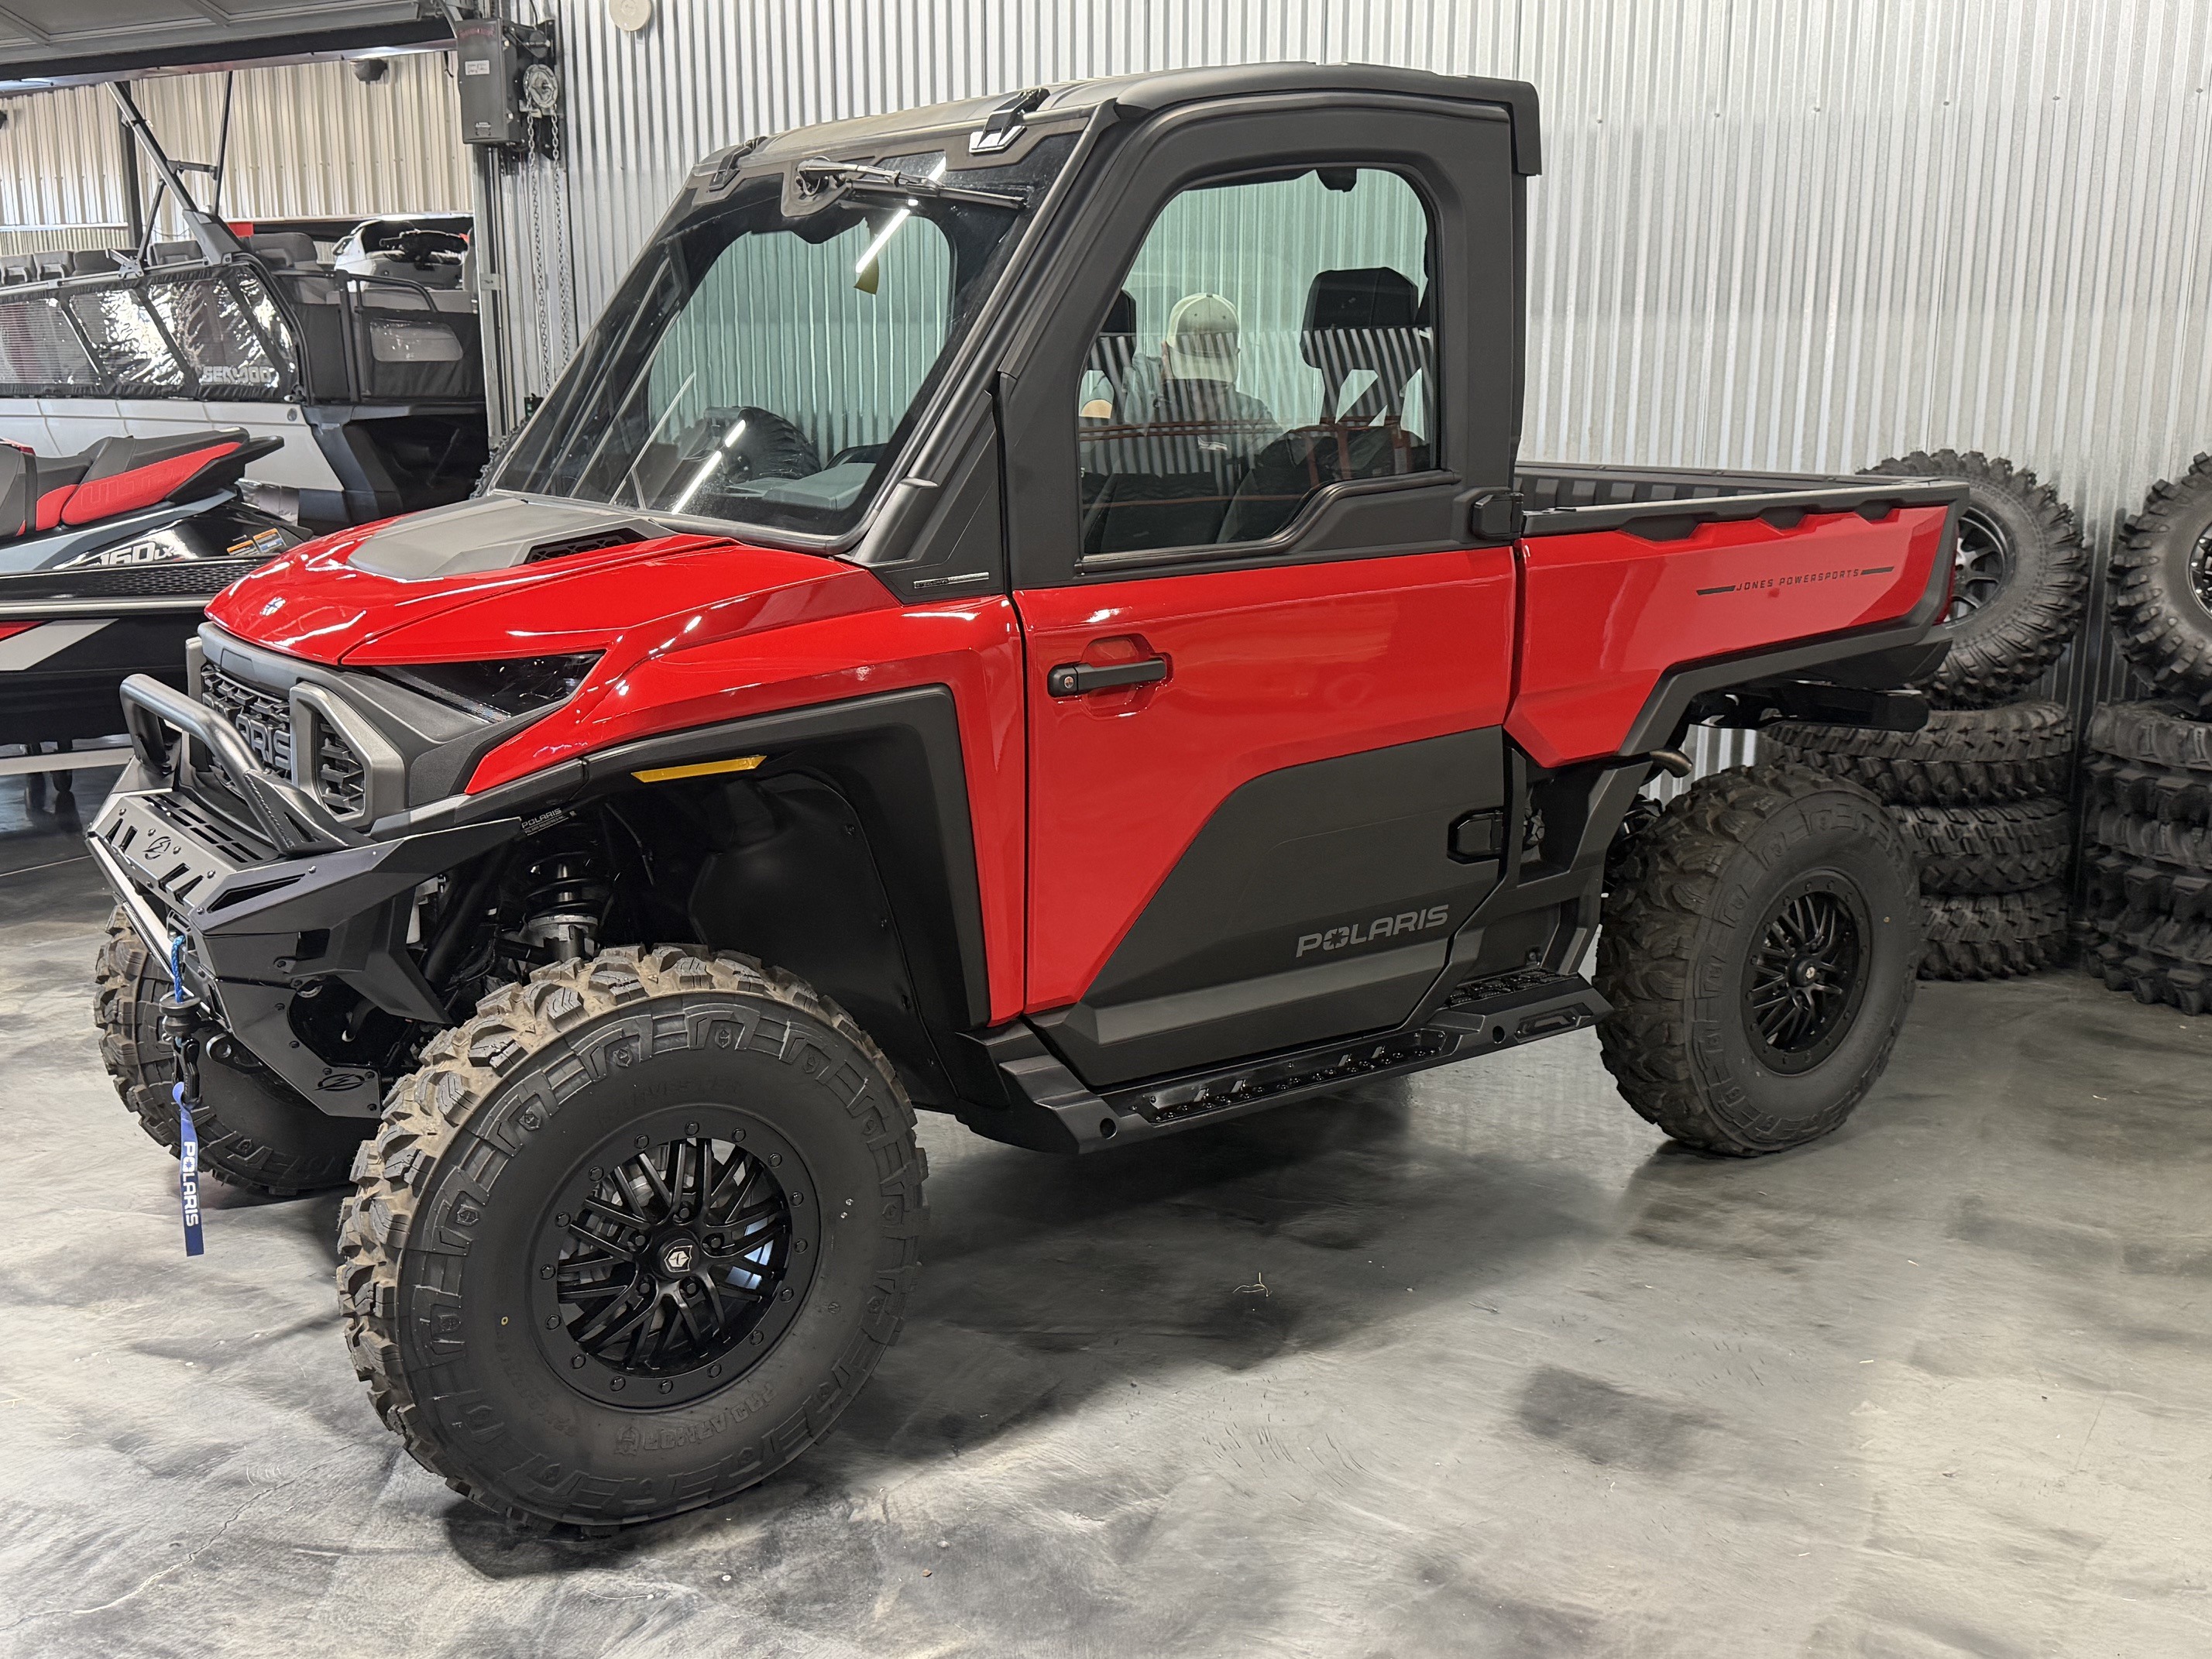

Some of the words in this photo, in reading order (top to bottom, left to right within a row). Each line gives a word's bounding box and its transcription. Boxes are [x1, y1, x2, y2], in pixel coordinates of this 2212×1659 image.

[1736, 578, 1774, 592] JONES
[1779, 568, 1860, 586] POWERSPORTS
[521, 808, 562, 829] POLARIS
[1295, 903, 1449, 958] POLARIS
[182, 1141, 199, 1227] POLARIS
